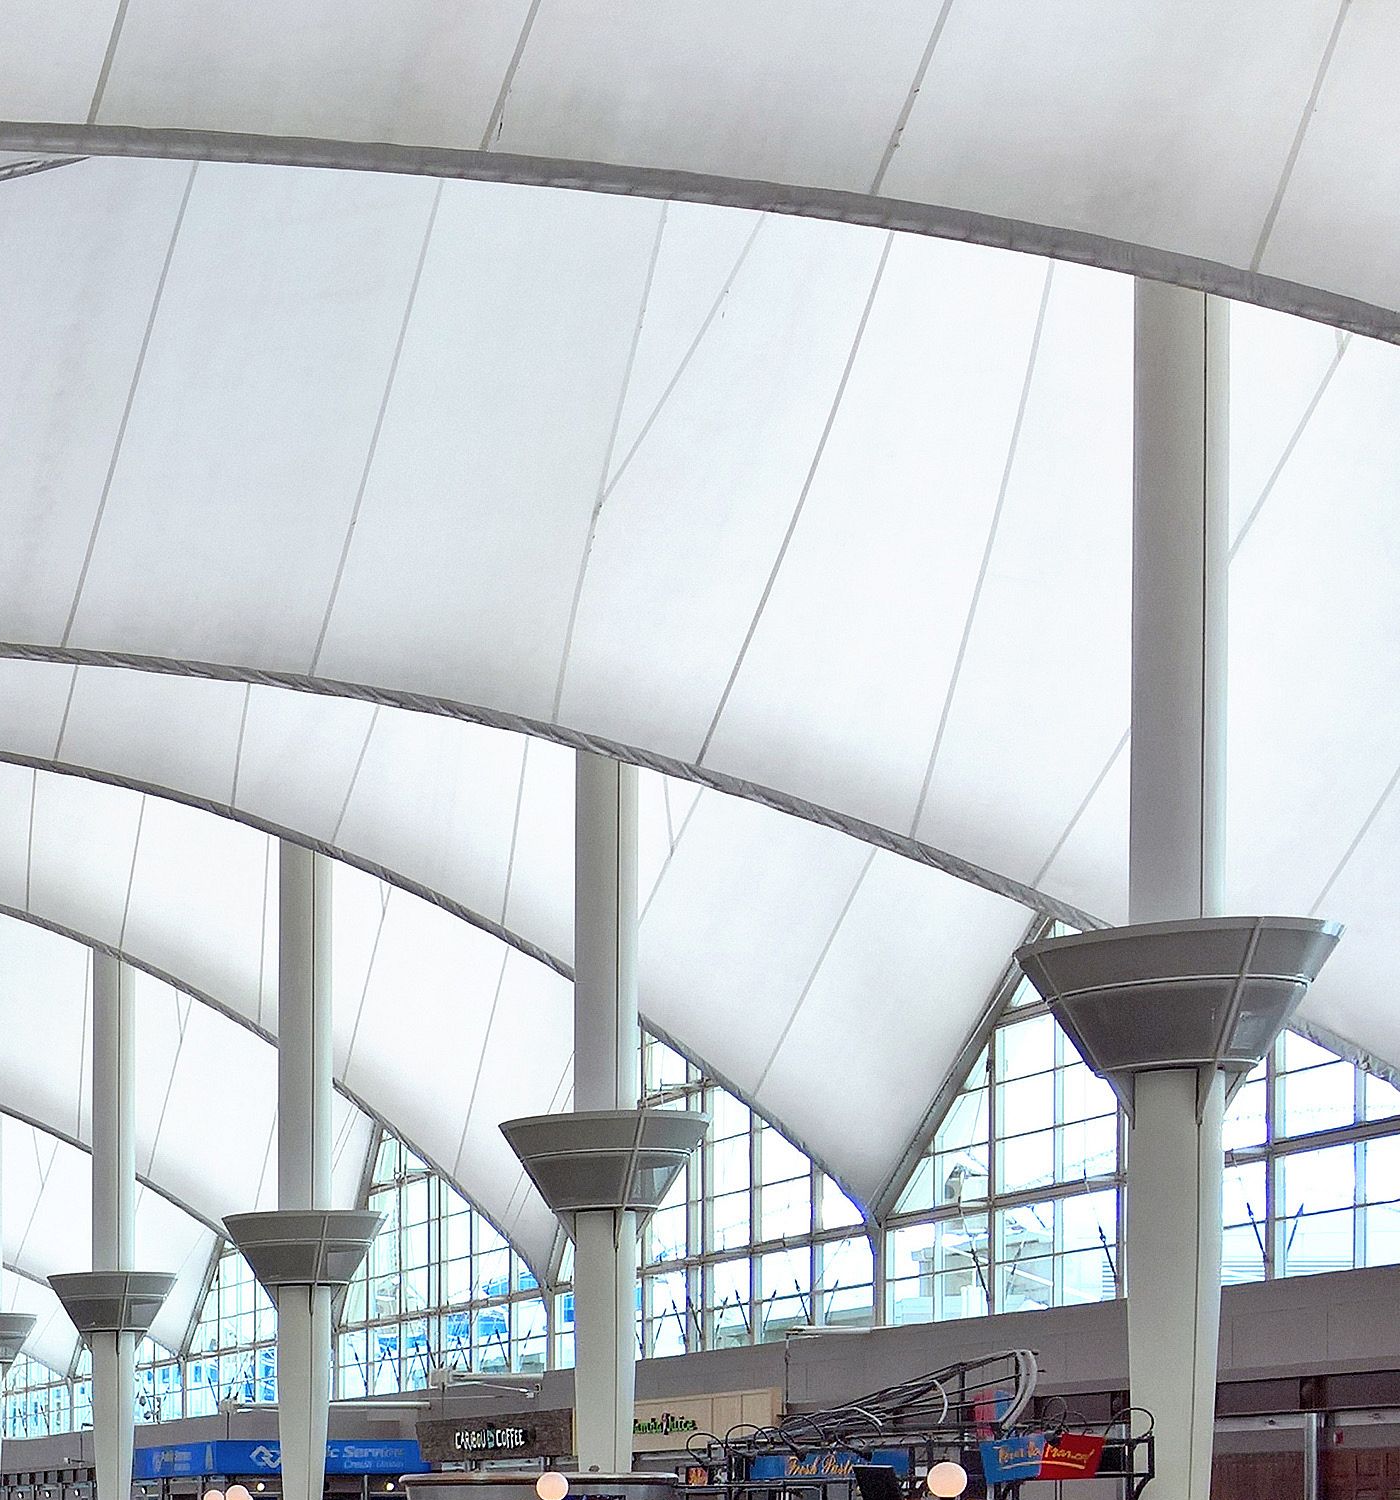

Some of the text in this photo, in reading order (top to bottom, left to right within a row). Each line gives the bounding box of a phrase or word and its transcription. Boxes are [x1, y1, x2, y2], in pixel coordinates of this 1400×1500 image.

[633, 1418, 663, 1434] amba
[455, 1428, 525, 1451] CARIBOU COFFEE
